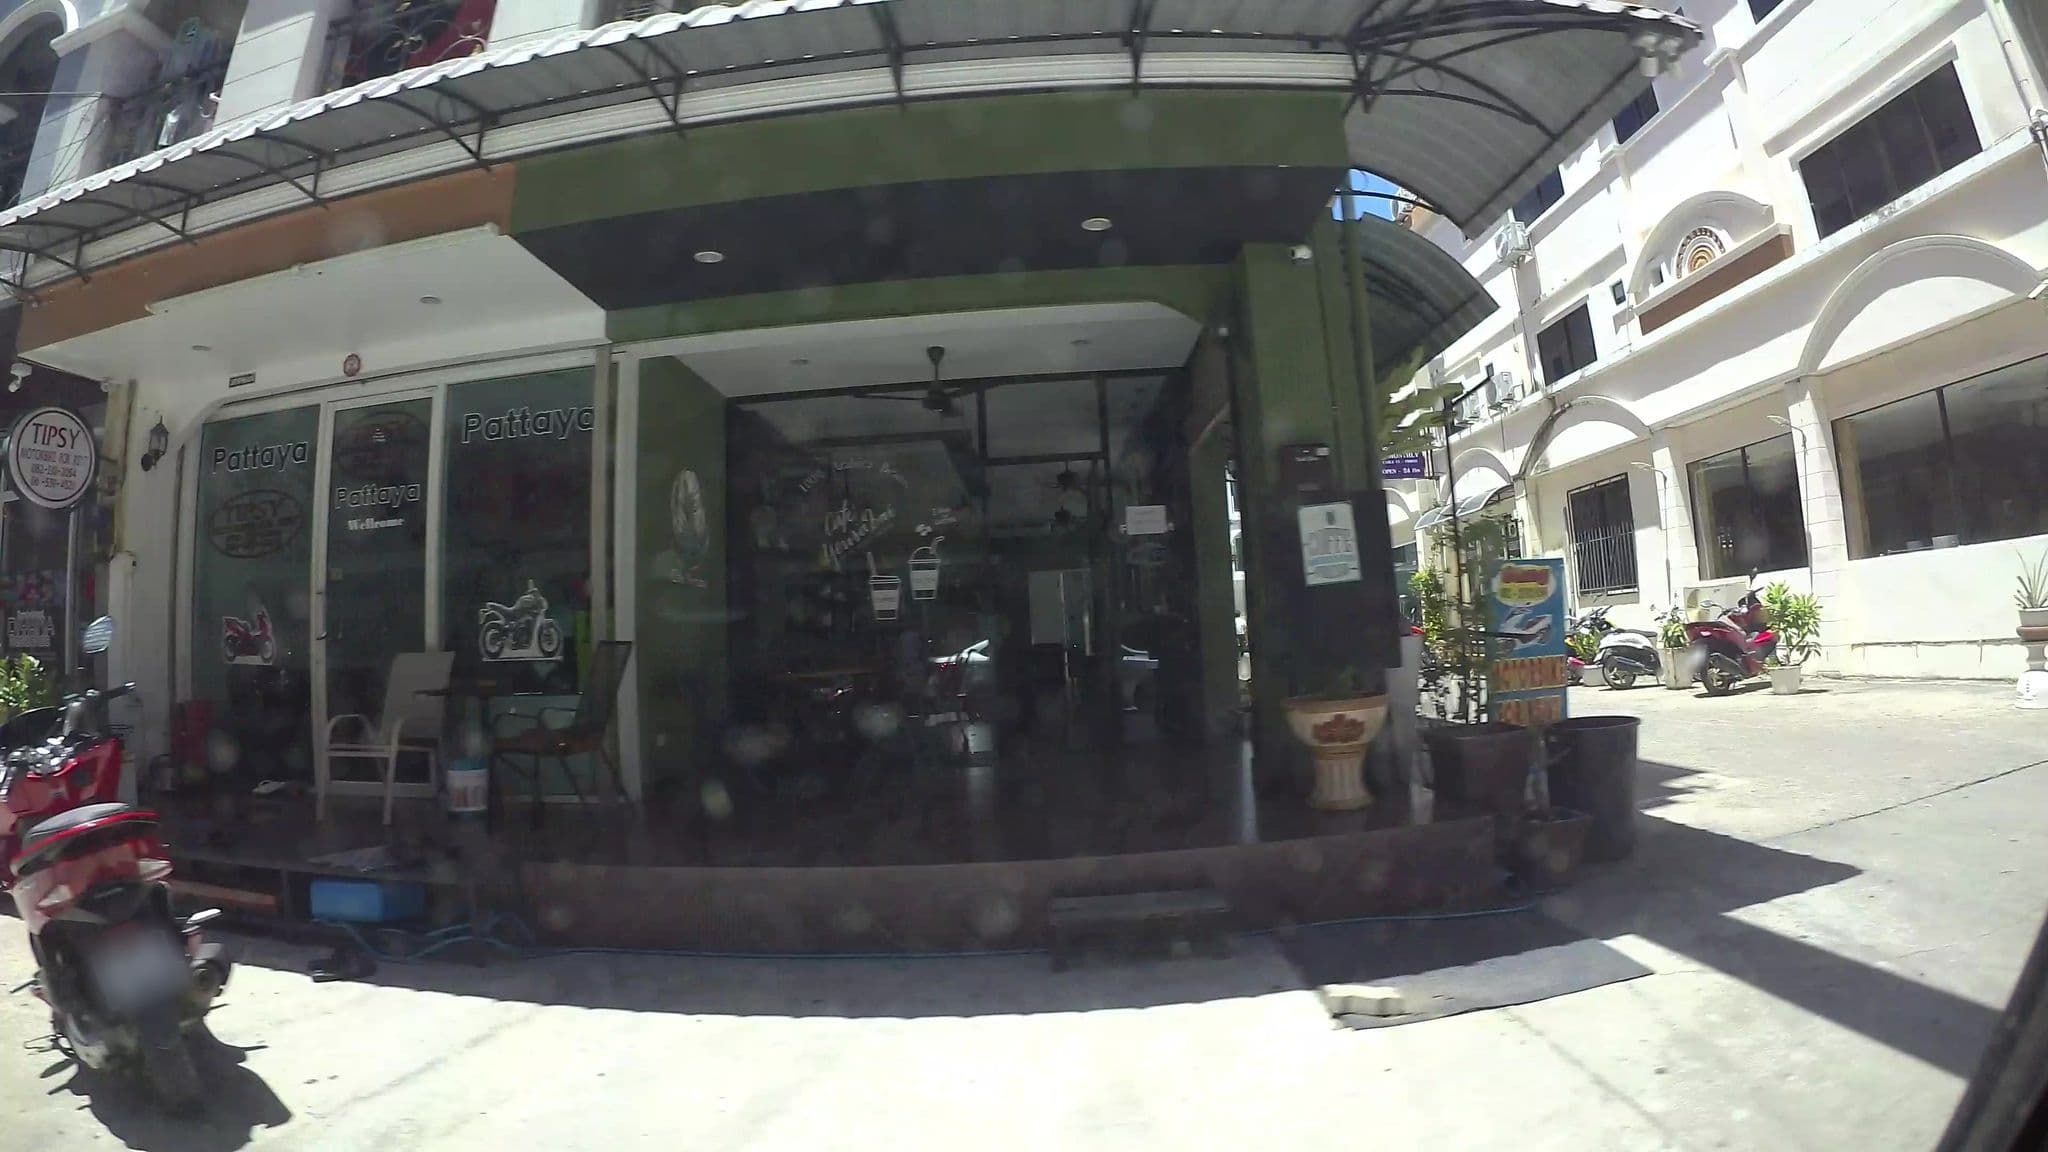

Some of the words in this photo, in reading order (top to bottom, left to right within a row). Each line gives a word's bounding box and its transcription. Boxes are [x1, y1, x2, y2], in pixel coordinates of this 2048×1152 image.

[32, 422, 81, 450] TIPSY
[461, 406, 595, 444] Pattaya
[212, 441, 309, 475] Pattaya
[335, 483, 421, 510] Pattaya
